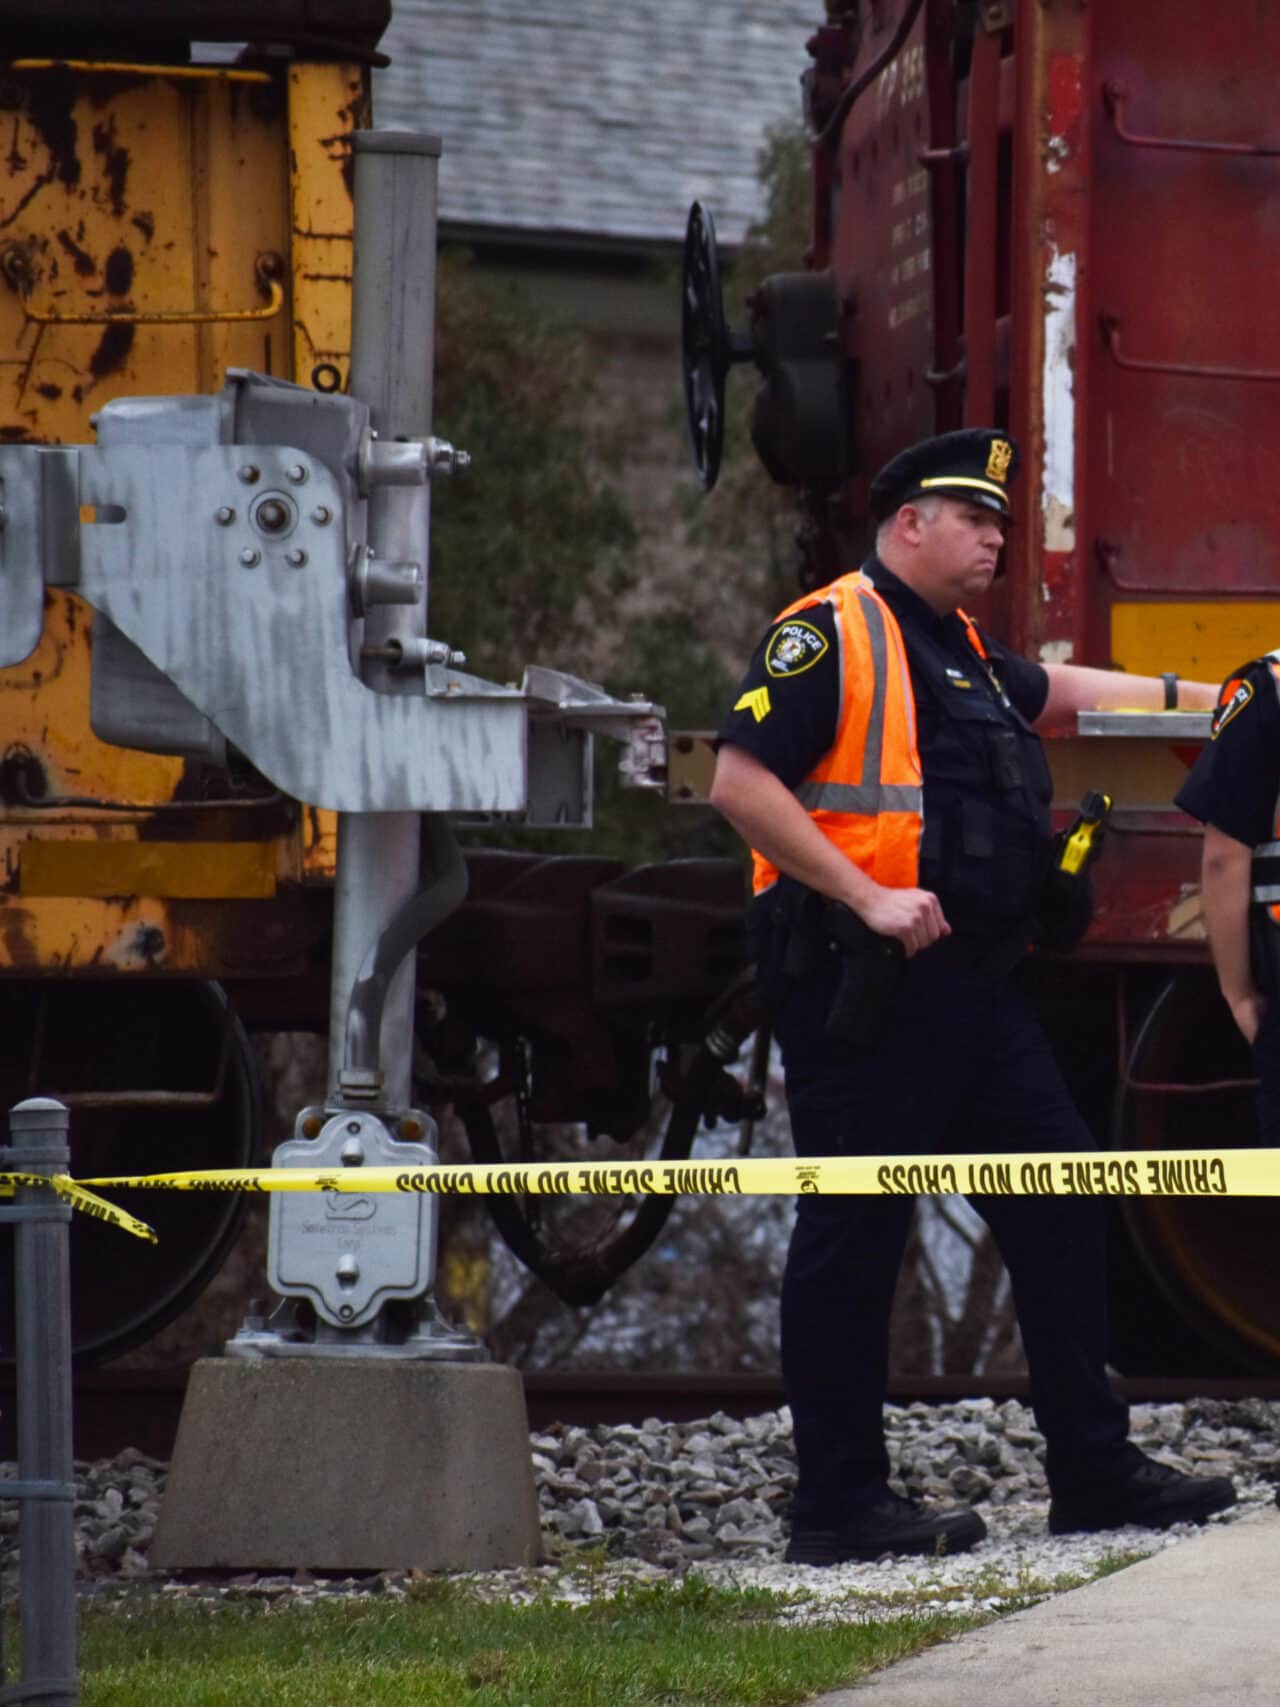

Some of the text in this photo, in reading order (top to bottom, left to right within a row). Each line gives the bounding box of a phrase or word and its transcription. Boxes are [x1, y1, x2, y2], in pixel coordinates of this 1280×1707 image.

[782, 626, 823, 651] POLICE
[578, 1170, 654, 1192] SCENE
[662, 1167, 740, 1192] CRIME
[877, 1158, 1227, 1193] CRIME SCENE DO NOT CROSS
